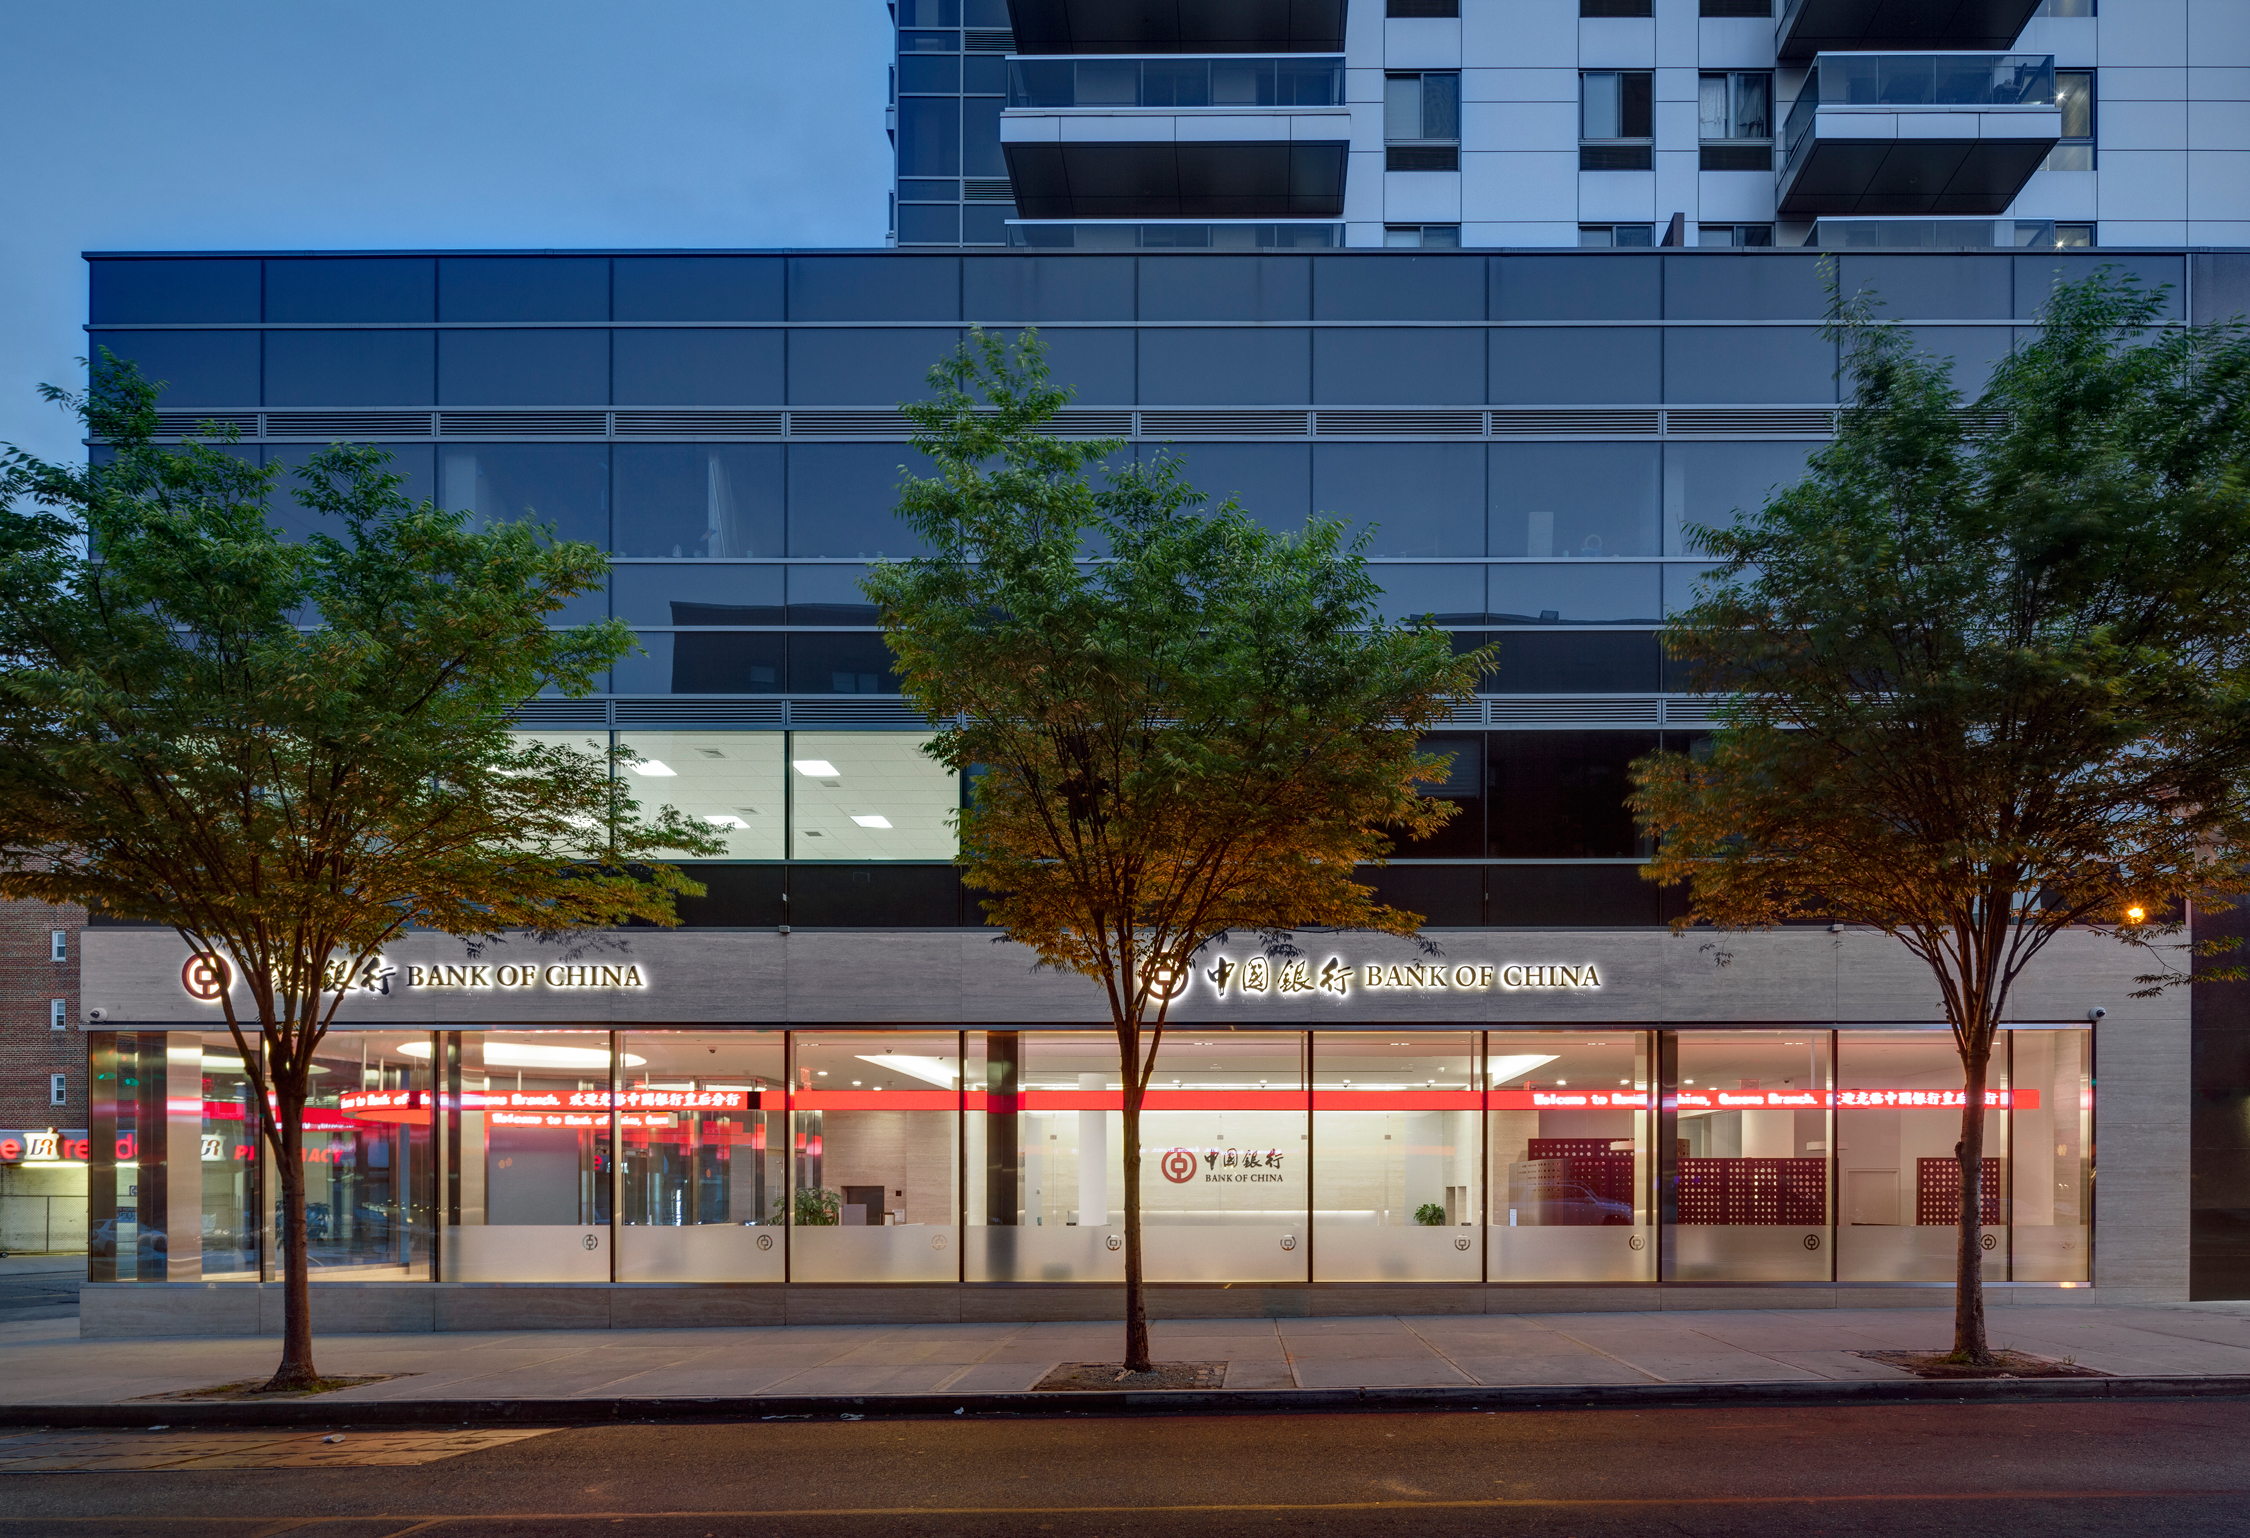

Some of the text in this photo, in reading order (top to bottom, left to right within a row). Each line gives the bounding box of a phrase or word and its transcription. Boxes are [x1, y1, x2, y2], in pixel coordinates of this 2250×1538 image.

[406, 964, 644, 986] BANK OF CHINA
[1366, 965, 1601, 986] BANK OF CHINA
[1205, 1174, 1284, 1183] BANK OF CHINA
